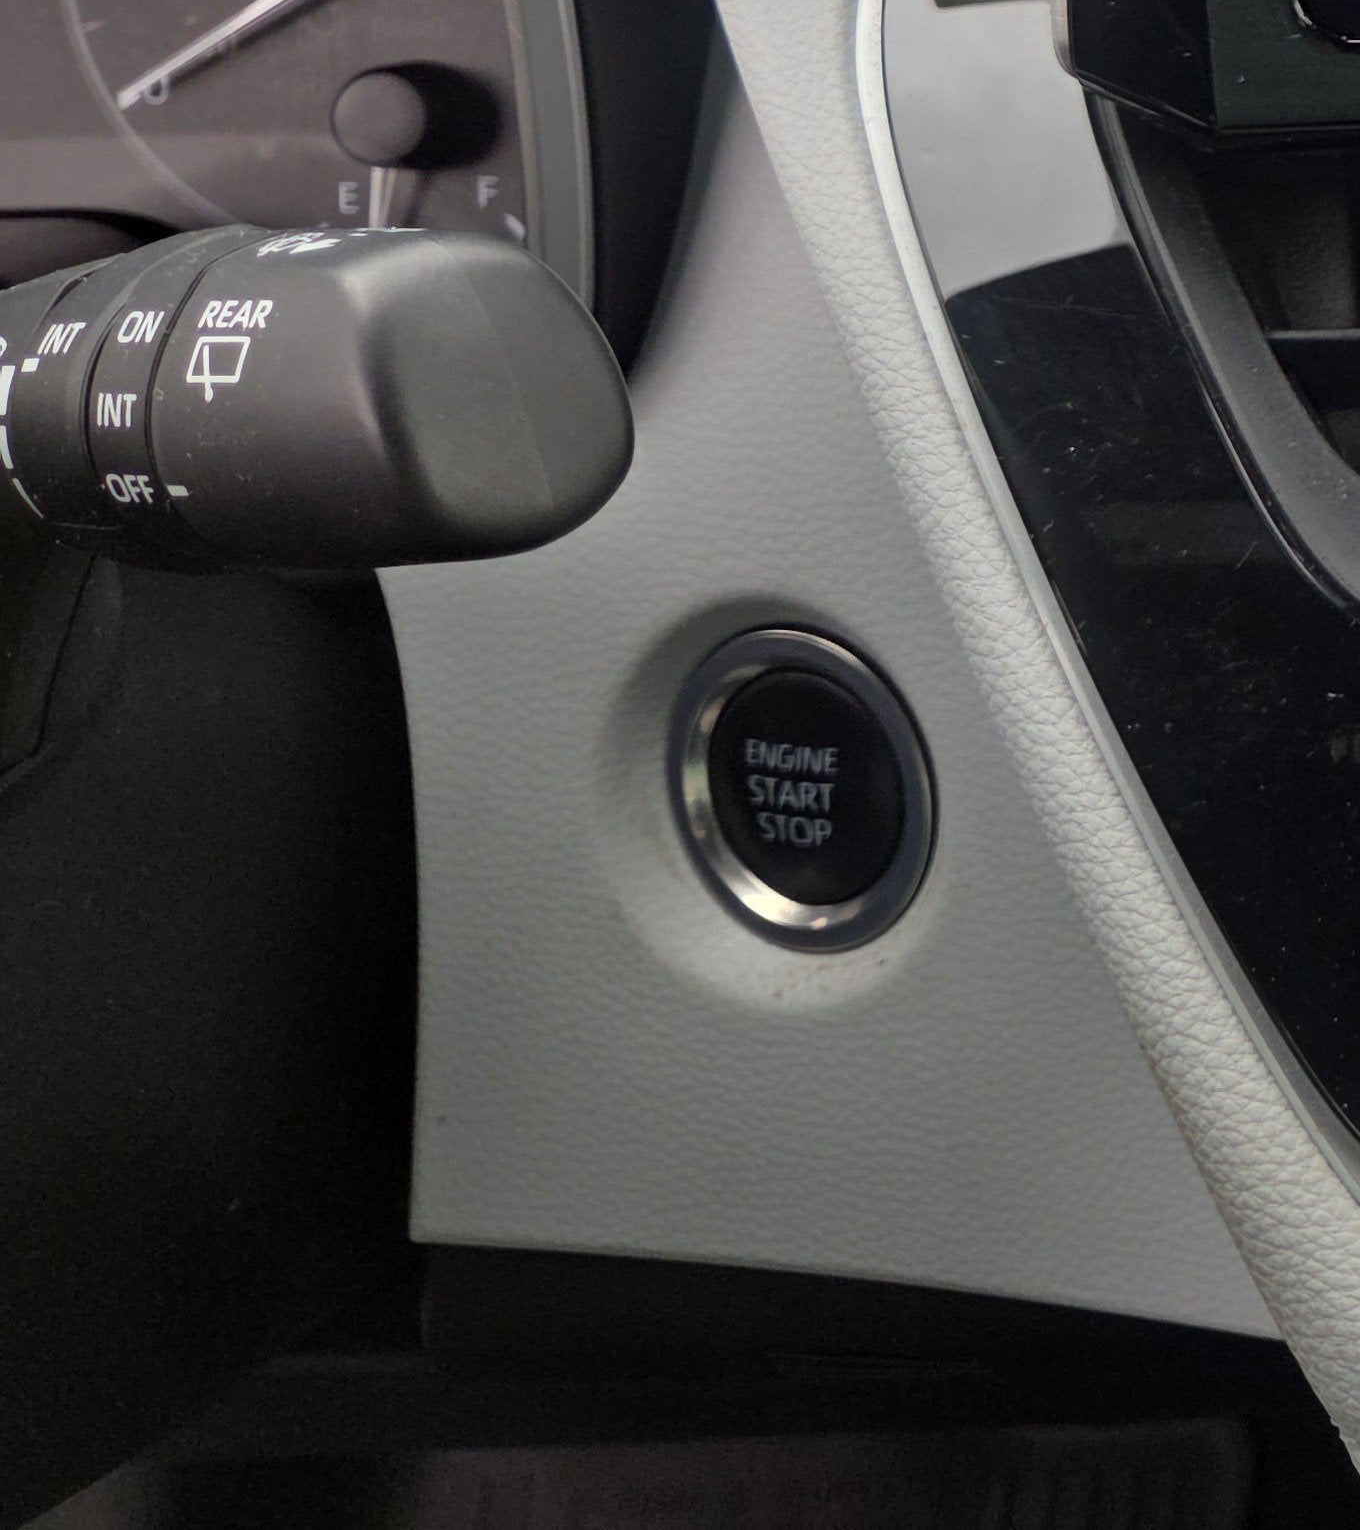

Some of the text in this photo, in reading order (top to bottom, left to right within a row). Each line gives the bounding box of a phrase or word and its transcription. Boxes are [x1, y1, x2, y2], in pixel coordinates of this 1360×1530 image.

[339, 182, 360, 214] E
[476, 176, 499, 208] F
[117, 310, 164, 344] ON
[198, 300, 274, 329] REAR
[38, 322, 86, 355] INT
[97, 392, 138, 427] INT
[105, 473, 155, 504] OFF
[746, 738, 840, 774] ENGINE
[749, 775, 834, 812] START
[758, 814, 832, 847] STOP
